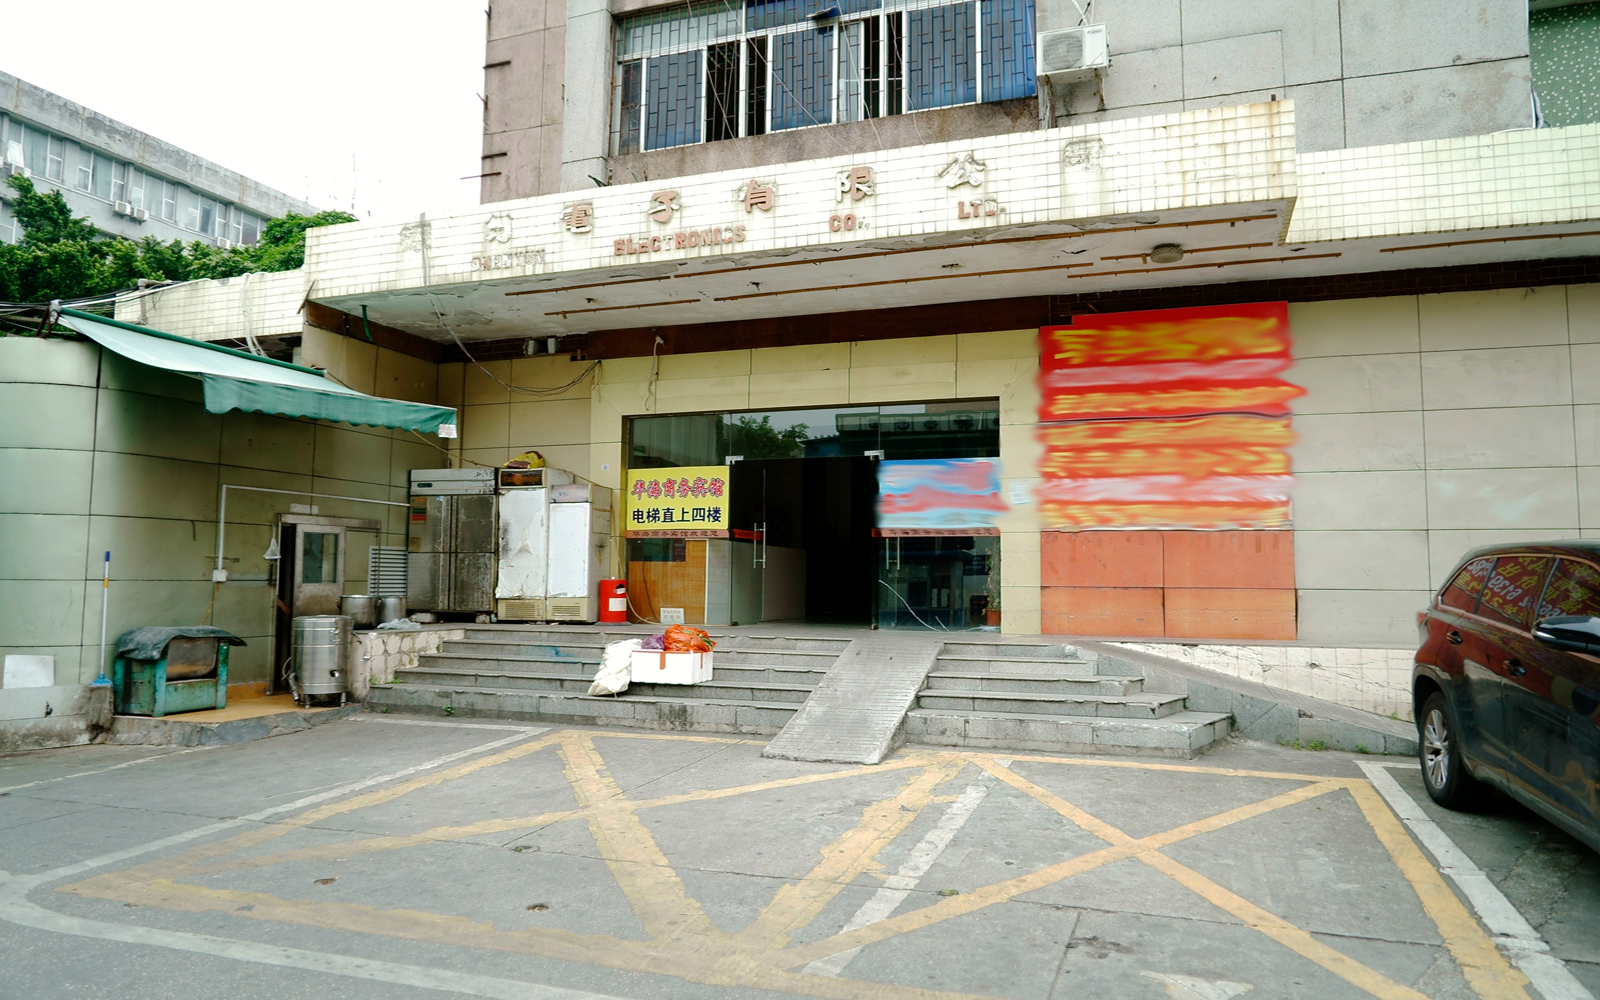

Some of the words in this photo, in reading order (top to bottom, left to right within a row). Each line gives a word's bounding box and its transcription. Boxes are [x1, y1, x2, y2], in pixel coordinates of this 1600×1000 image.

[613, 225, 747, 256] ELECTRONICS
[632, 477, 725, 500] 华海商务宾馆
[632, 506, 722, 524] 电梯直上四楼
